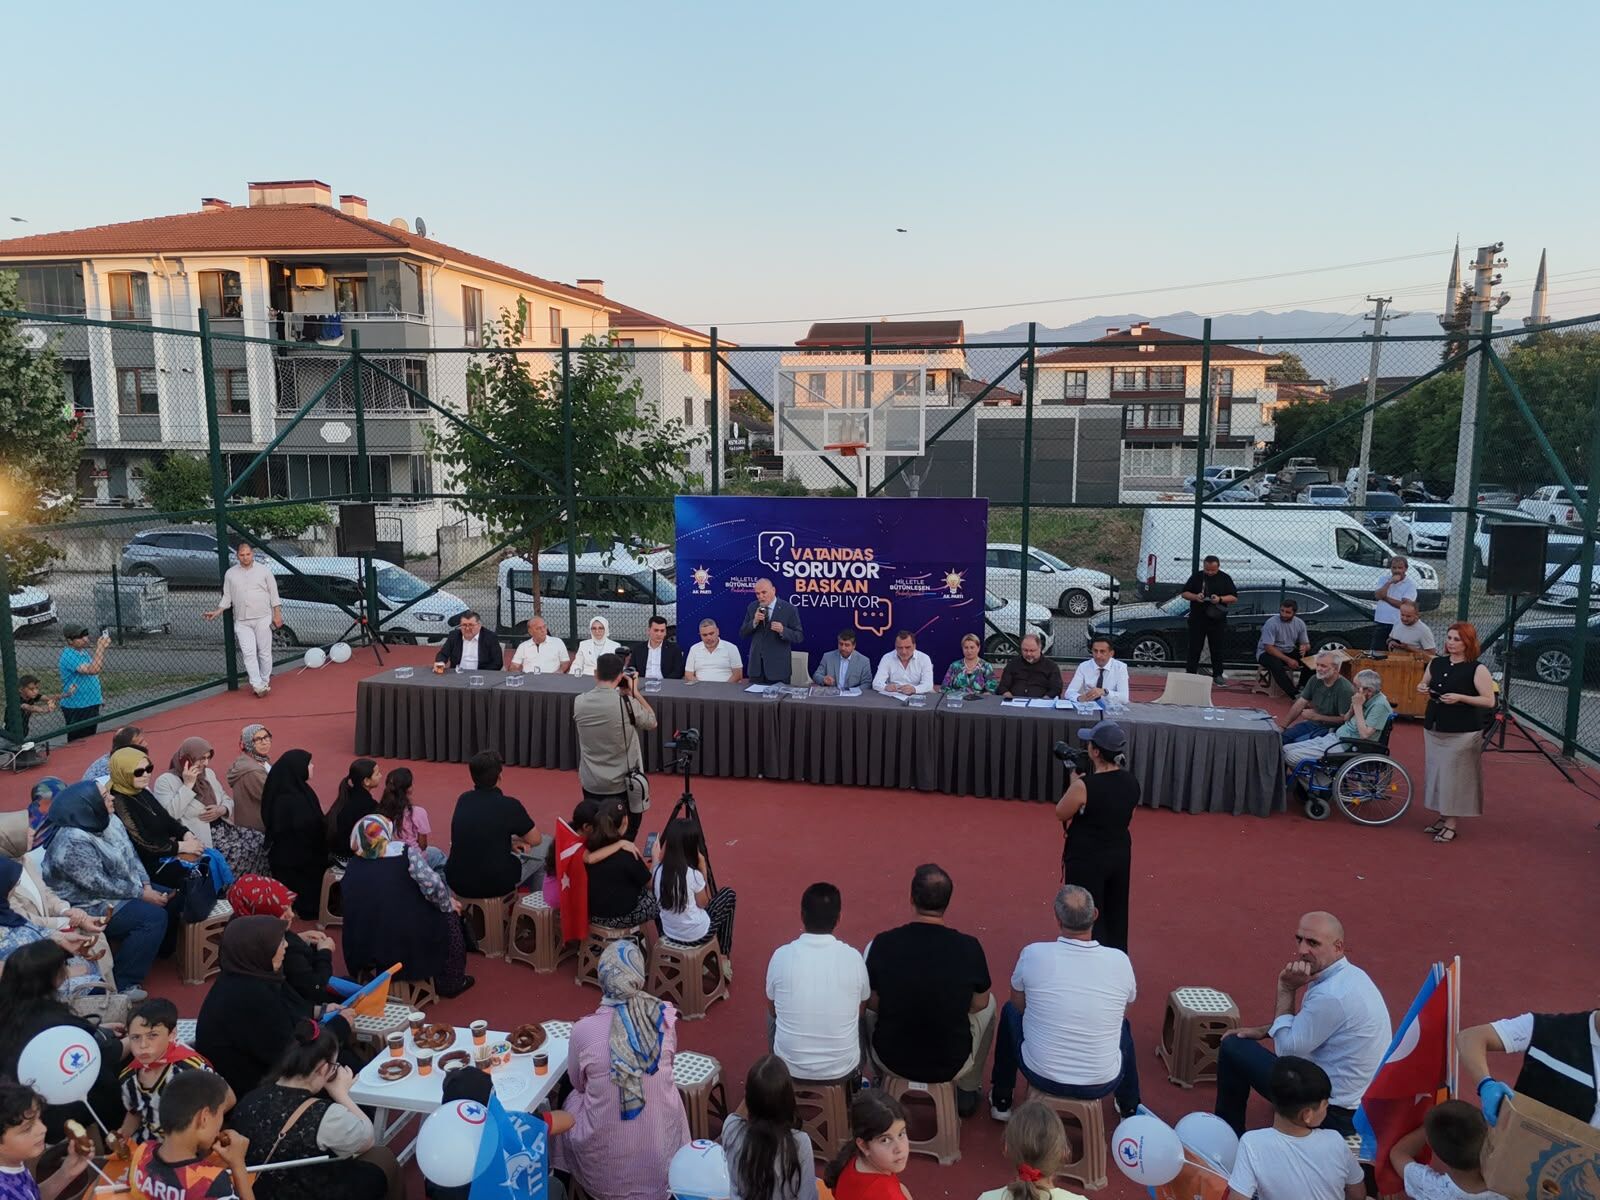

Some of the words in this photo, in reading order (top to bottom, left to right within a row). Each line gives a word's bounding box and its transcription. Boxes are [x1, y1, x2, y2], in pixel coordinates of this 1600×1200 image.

[782, 561, 880, 579] SORUYOR
[795, 579, 869, 593] BAŞKAN
[789, 594, 880, 608] CEVAPLIYOR
